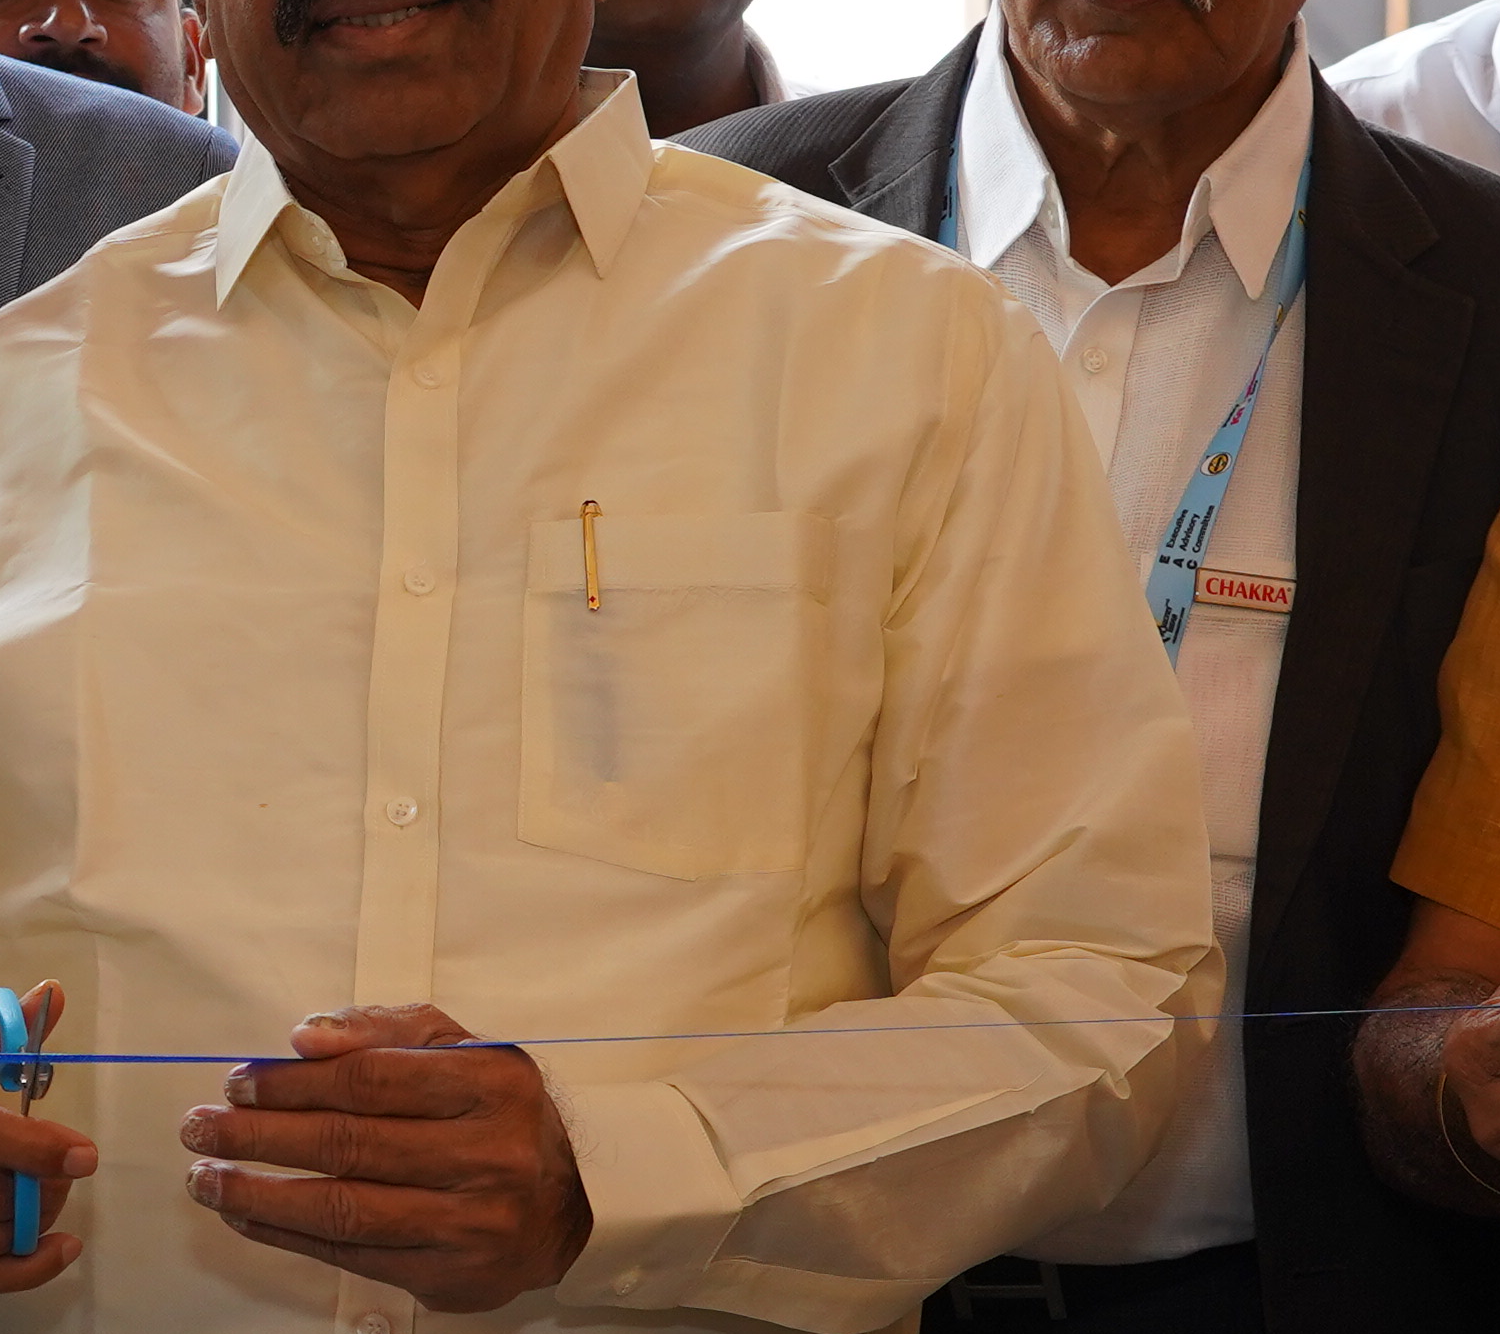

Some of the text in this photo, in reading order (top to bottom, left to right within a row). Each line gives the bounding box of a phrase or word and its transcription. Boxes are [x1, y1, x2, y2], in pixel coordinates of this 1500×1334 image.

[1158, 509, 1188, 564] E Executive
[1173, 513, 1200, 568] A Advisory
[1186, 505, 1215, 570] C Committee
